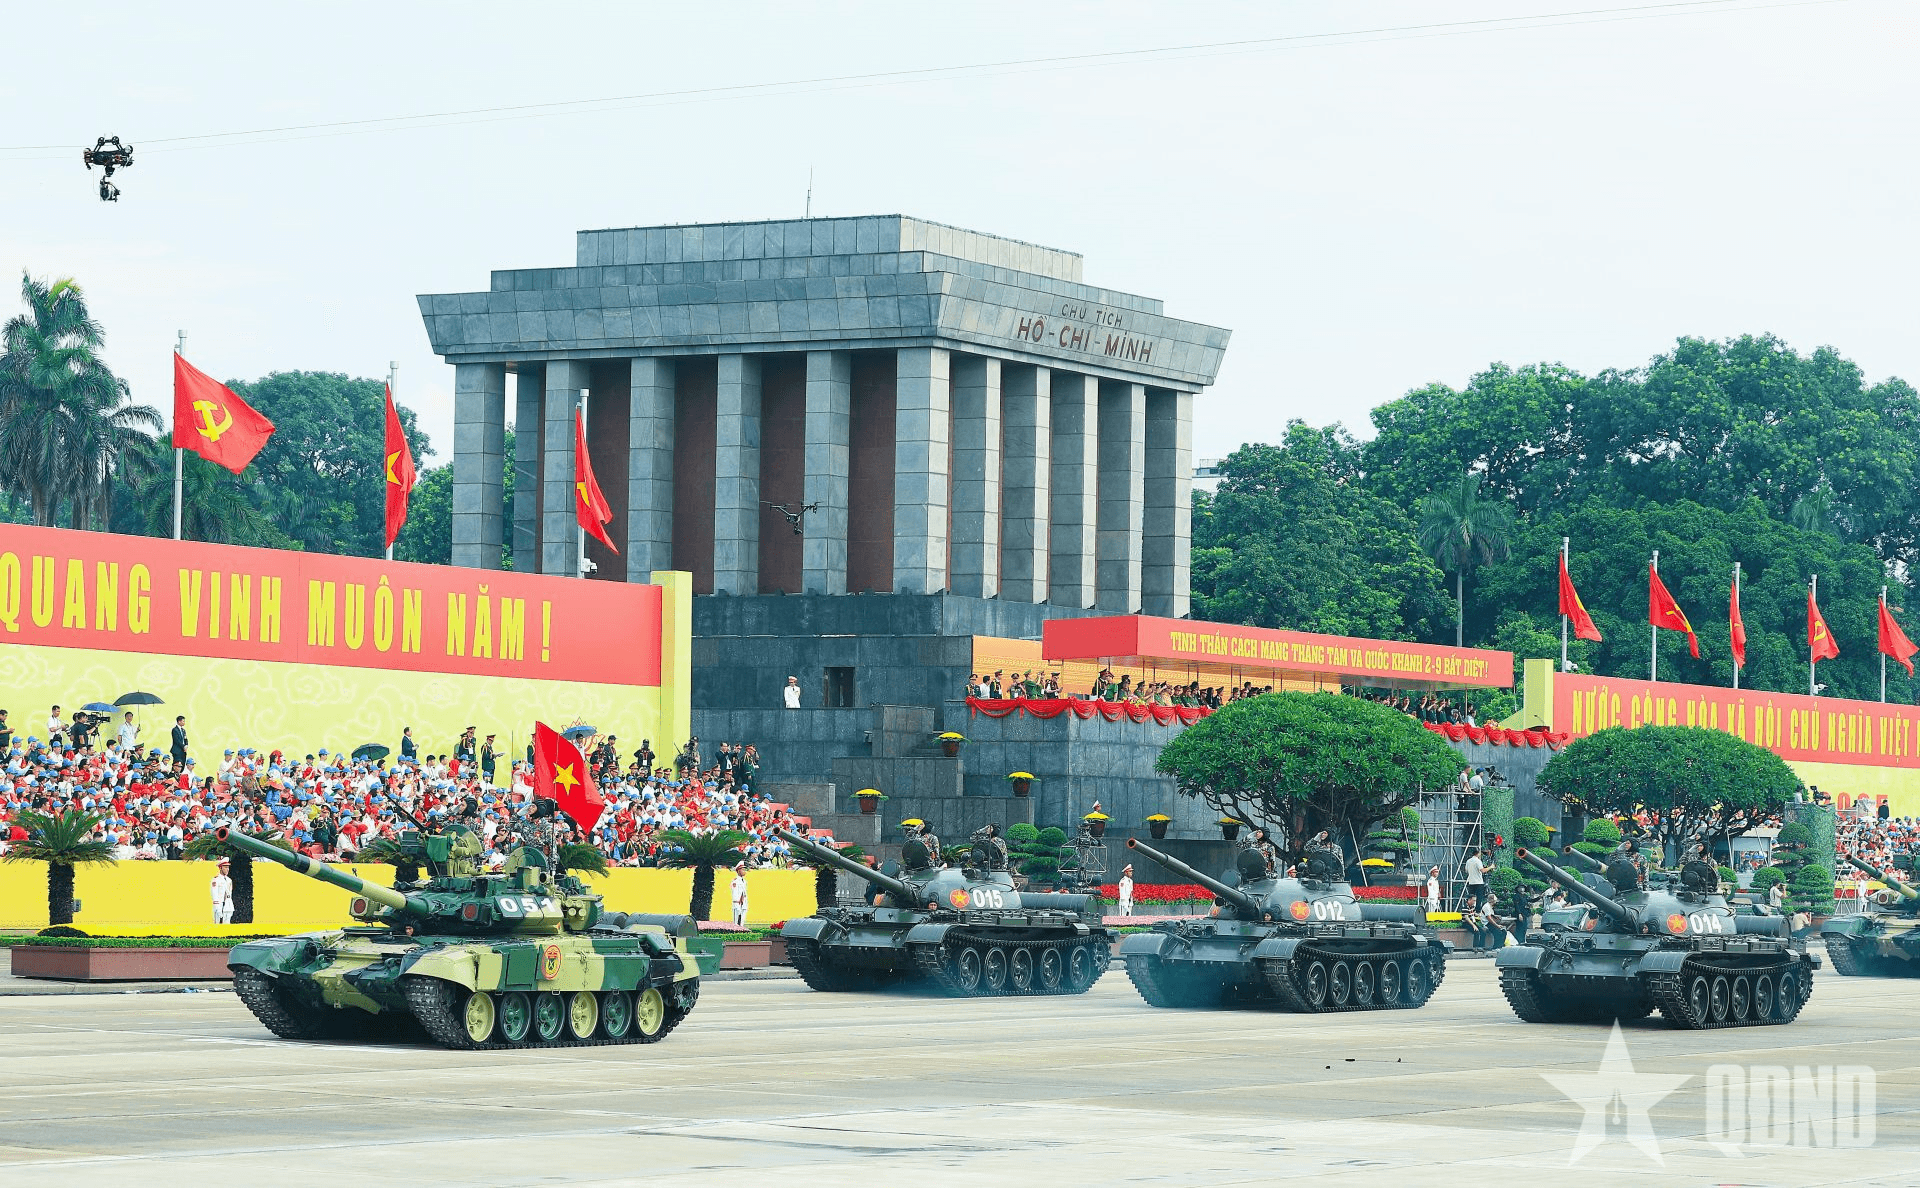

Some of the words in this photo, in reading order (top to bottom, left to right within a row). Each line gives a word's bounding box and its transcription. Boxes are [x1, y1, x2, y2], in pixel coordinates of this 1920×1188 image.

[0, 551, 151, 634] QUANG
[178, 568, 282, 643] VINH
[307, 574, 422, 653] MUÔN
[446, 583, 525, 661] NĂM
[1170, 631, 1197, 653] TINH
[1231, 634, 1258, 659] CÁCH
[1260, 640, 1289, 664] MẠNG
[1291, 641, 1325, 665] THÁNG
[1327, 644, 1348, 667] TÁM
[1365, 646, 1390, 671] QUỐC
[1392, 650, 1423, 673] KHÁNH
[1425, 656, 1442, 675] 2-9
[1443, 654, 1462, 677] BẤT
[1572, 685, 1621, 736] NƯỚC
[1789, 701, 1820, 751] CHỦ
[1880, 711, 1910, 764] VIỆT
[499, 897, 556, 913] 051
[972, 889, 1003, 909] 015
[1313, 900, 1346, 921] 012
[1689, 913, 1722, 934] 014
